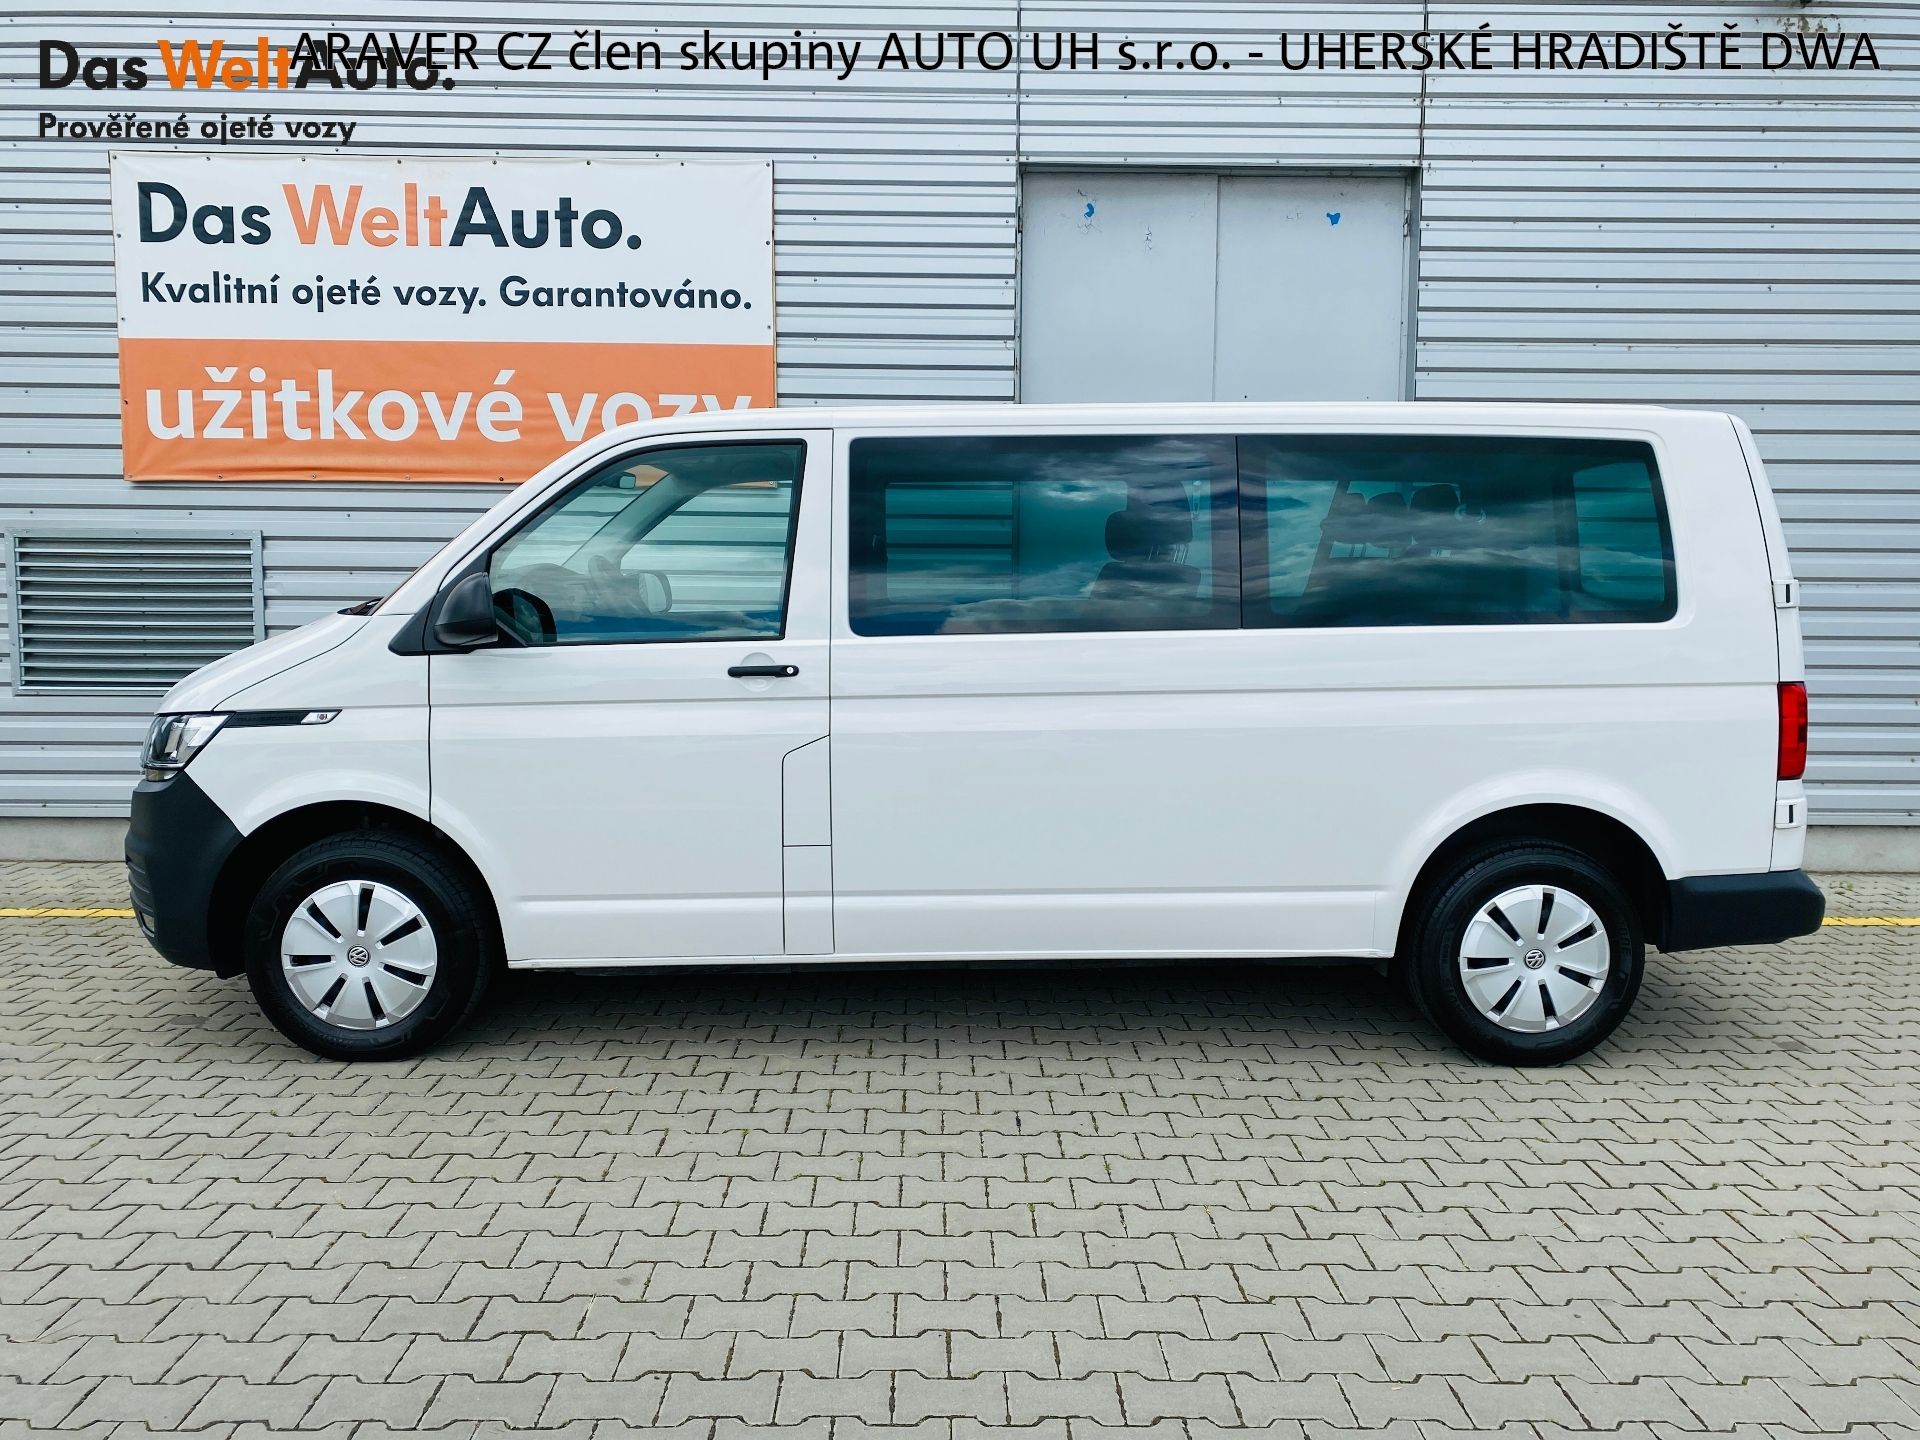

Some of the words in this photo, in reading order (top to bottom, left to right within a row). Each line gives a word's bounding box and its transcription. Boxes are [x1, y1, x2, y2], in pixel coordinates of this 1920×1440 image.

[137, 181, 272, 246] Das
[283, 182, 643, 251] WeltAuto.
[141, 270, 281, 306] Kvalitní
[292, 275, 382, 314] ojeté
[394, 285, 487, 315] vozy.
[500, 276, 753, 311] Garantováno.
[145, 366, 524, 443] užitkové
